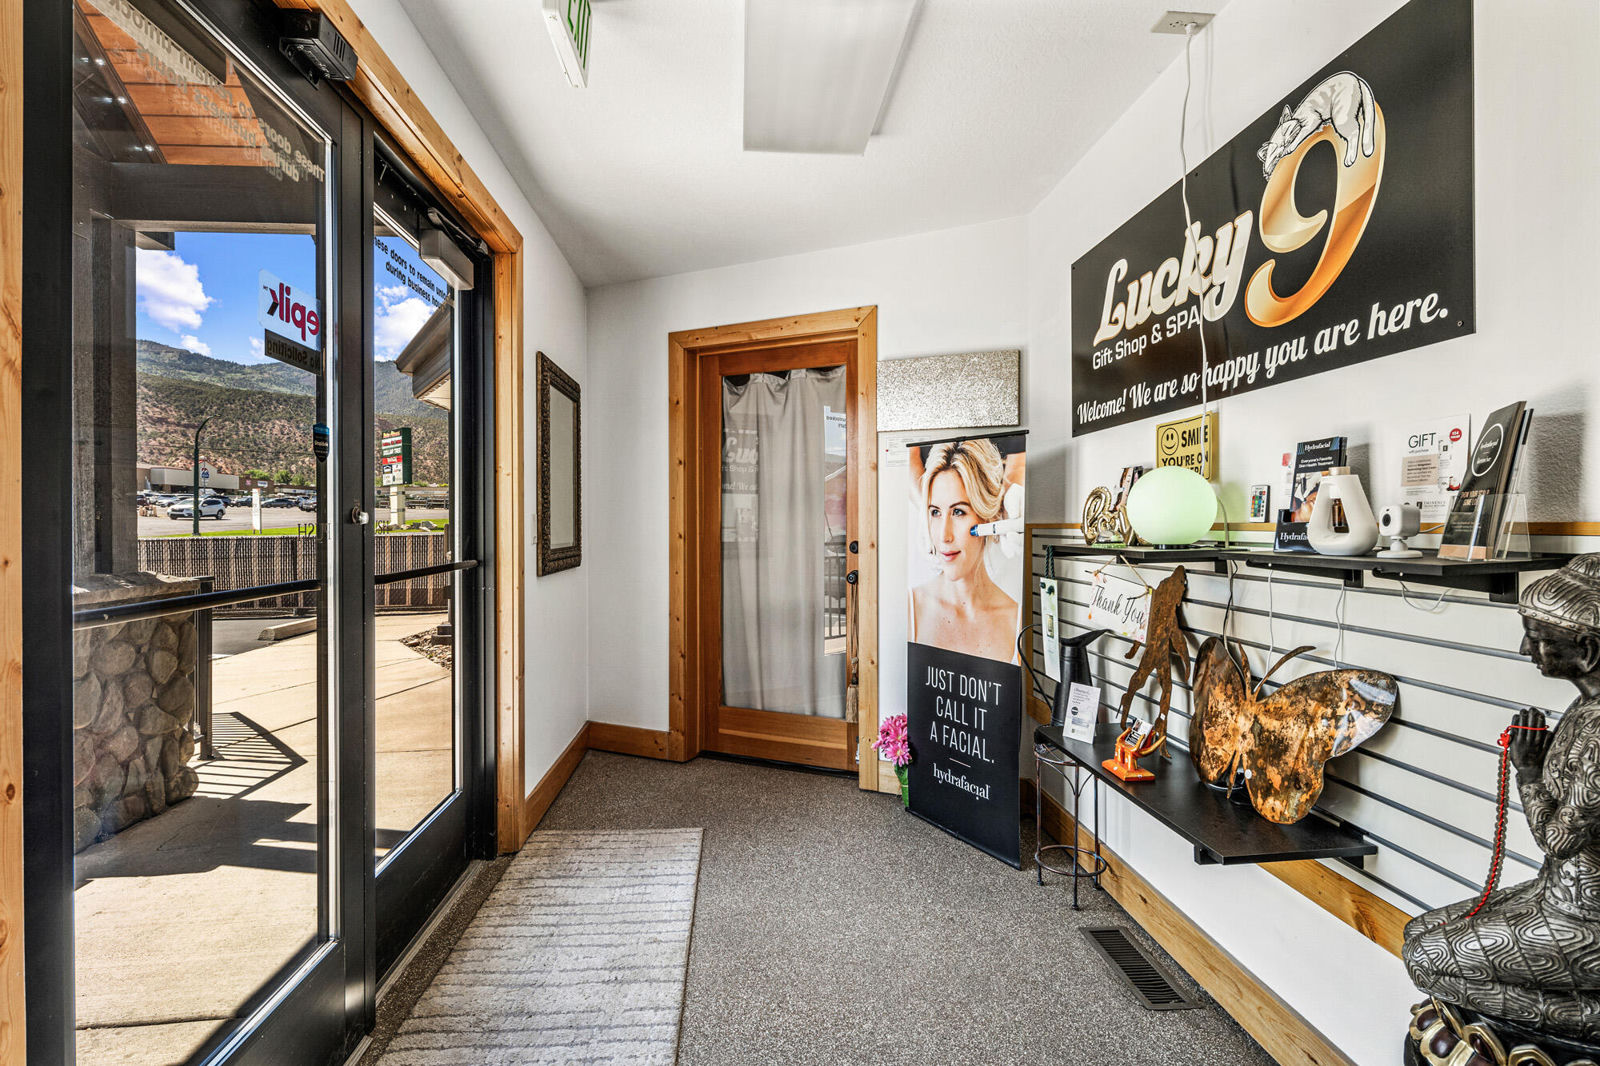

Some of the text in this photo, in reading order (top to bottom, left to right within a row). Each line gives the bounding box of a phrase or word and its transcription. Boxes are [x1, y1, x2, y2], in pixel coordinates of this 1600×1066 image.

[1093, 99, 1387, 347] Lucky 9
[385, 261, 406, 285] during
[407, 277, 431, 302] business
[390, 249, 407, 270] doors
[408, 264, 416, 276] to
[1092, 305, 1201, 370] Gift Shop & SPA
[1077, 292, 1449, 425] Welcome! We are so happy you are here.
[1162, 454, 1195, 467] YOU'RE
[1408, 432, 1437, 449] GIFT
[1091, 584, 1146, 625] Thank You
[925, 665, 1002, 706] JUST DON'T
[936, 696, 988, 731] CALL IT
[930, 721, 995, 764] A FACIAL.
[933, 763, 991, 800] hydrafacial
